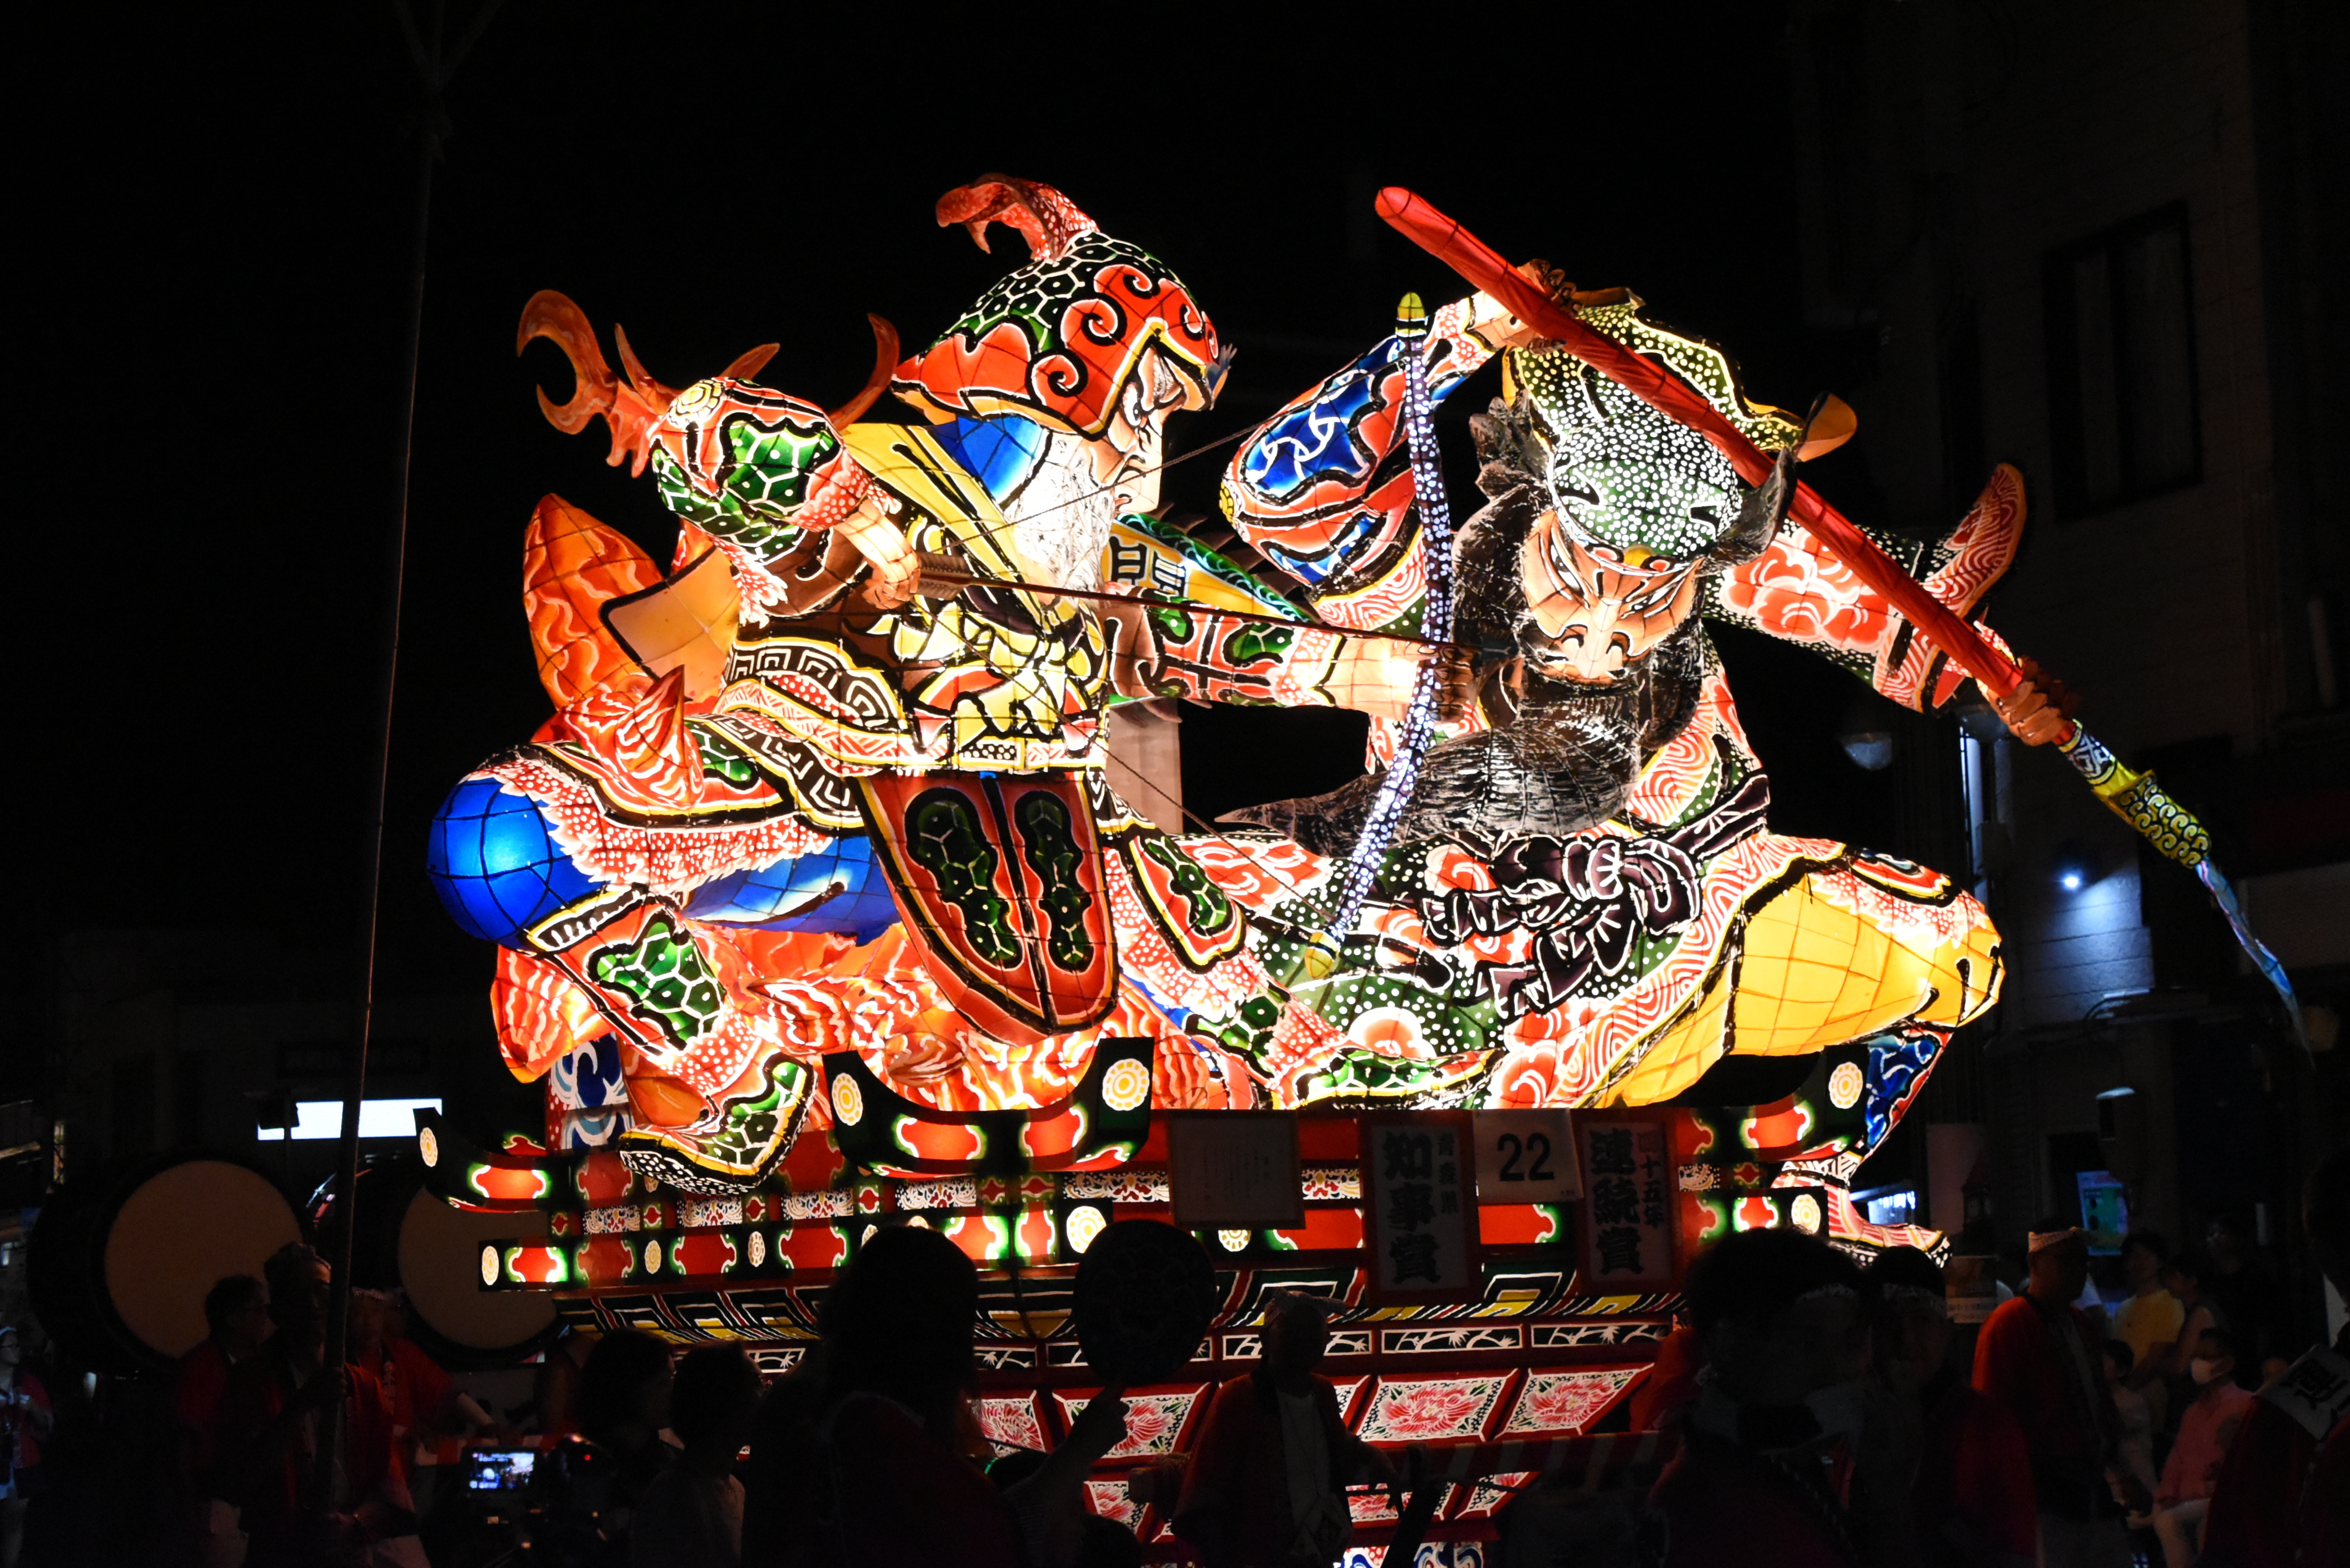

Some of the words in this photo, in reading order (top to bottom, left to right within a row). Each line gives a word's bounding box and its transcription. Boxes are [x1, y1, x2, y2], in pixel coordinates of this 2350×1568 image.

[1383, 1131, 1441, 1284] 知事賞
[1497, 1133, 1556, 1182] 22
[1589, 1127, 1644, 1275] 連続賞
